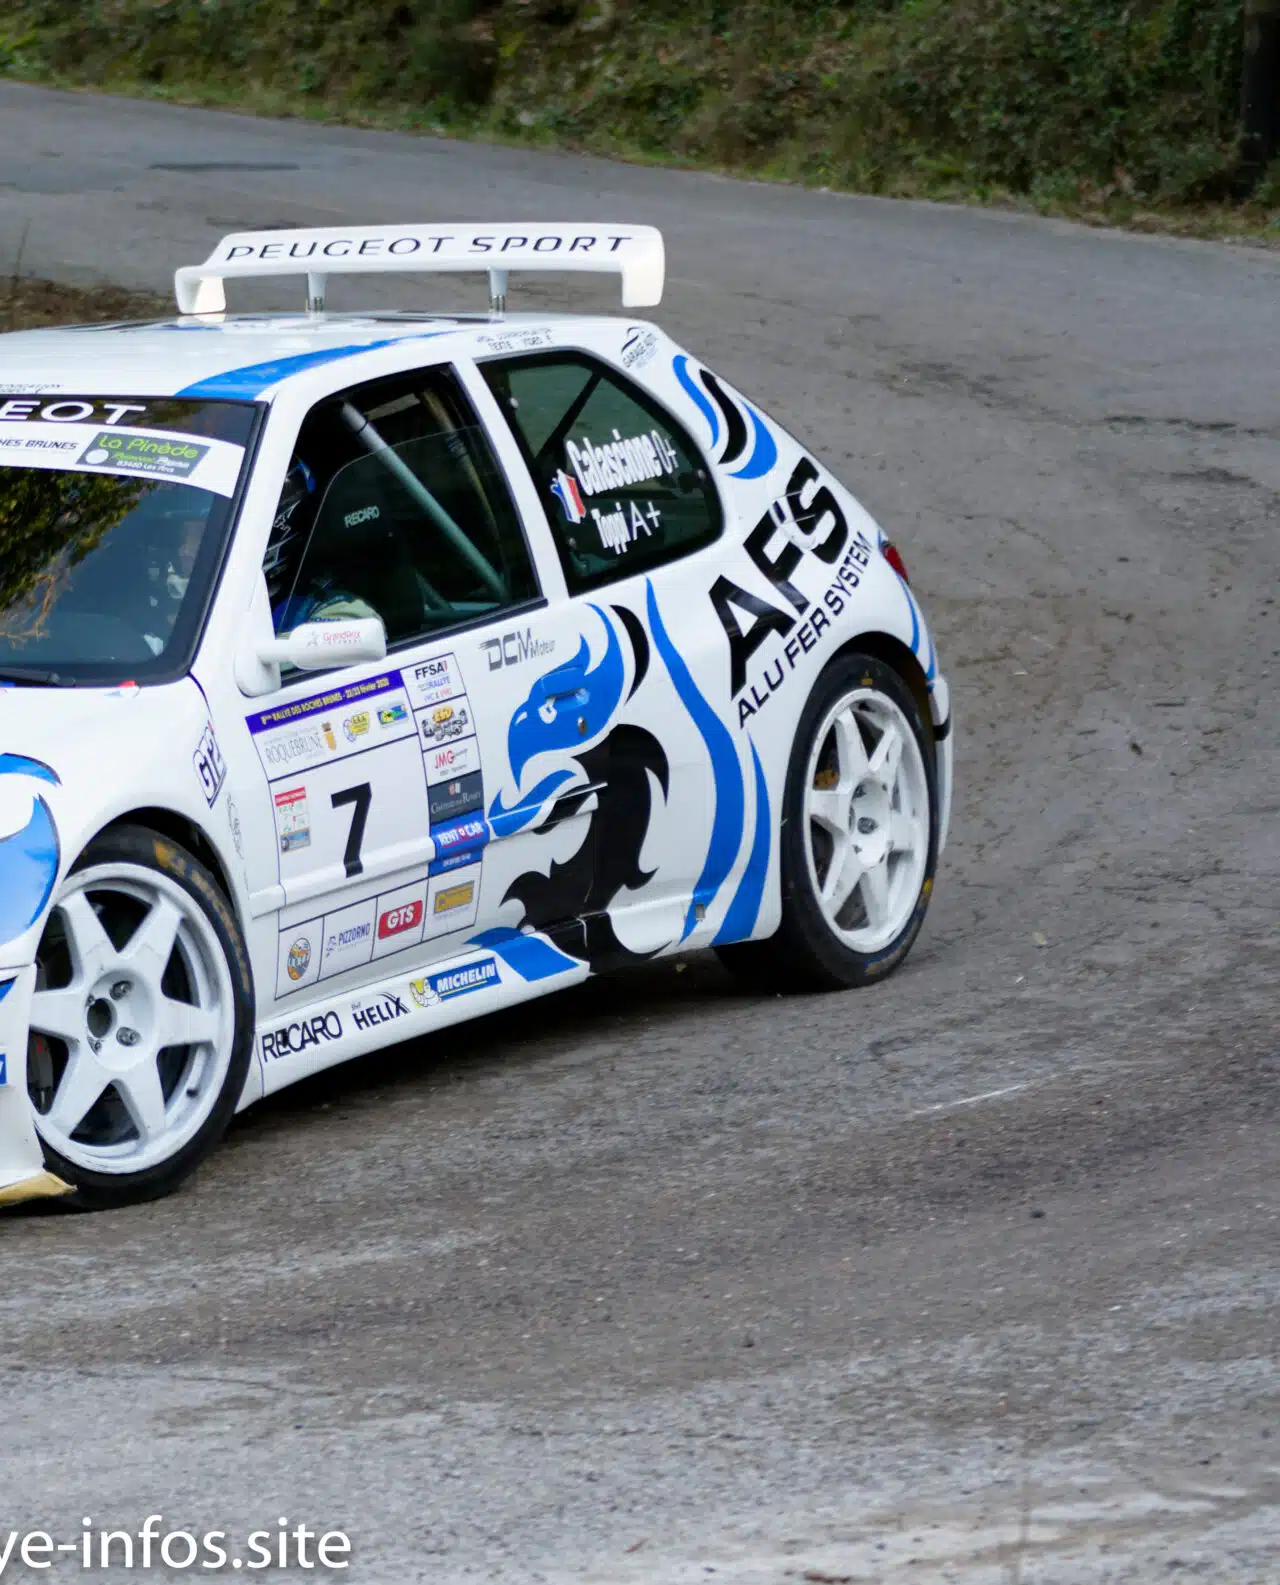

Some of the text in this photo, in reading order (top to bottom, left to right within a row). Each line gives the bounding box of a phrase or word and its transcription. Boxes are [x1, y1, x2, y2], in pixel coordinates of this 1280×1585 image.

[225, 235, 633, 262] PEUGEOT SPORT
[25, 439, 78, 451] BRUNES
[98, 435, 199, 459] La Pinède
[566, 428, 663, 497] Calascione
[344, 505, 380, 529] RECARO
[590, 500, 662, 555] Toppi A+
[708, 456, 849, 701] AFS
[737, 530, 873, 730] ALU FER SYSTEM
[480, 627, 534, 672] DCM
[415, 661, 446, 681] FFSA
[434, 750, 456, 769] JMG
[330, 781, 373, 879] 7
[386, 905, 415, 930] GTS
[338, 922, 371, 946] PIZZORNO
[436, 962, 497, 993] MICHELIN
[352, 996, 409, 1031] HELIX
[261, 1011, 344, 1063] RECARO
